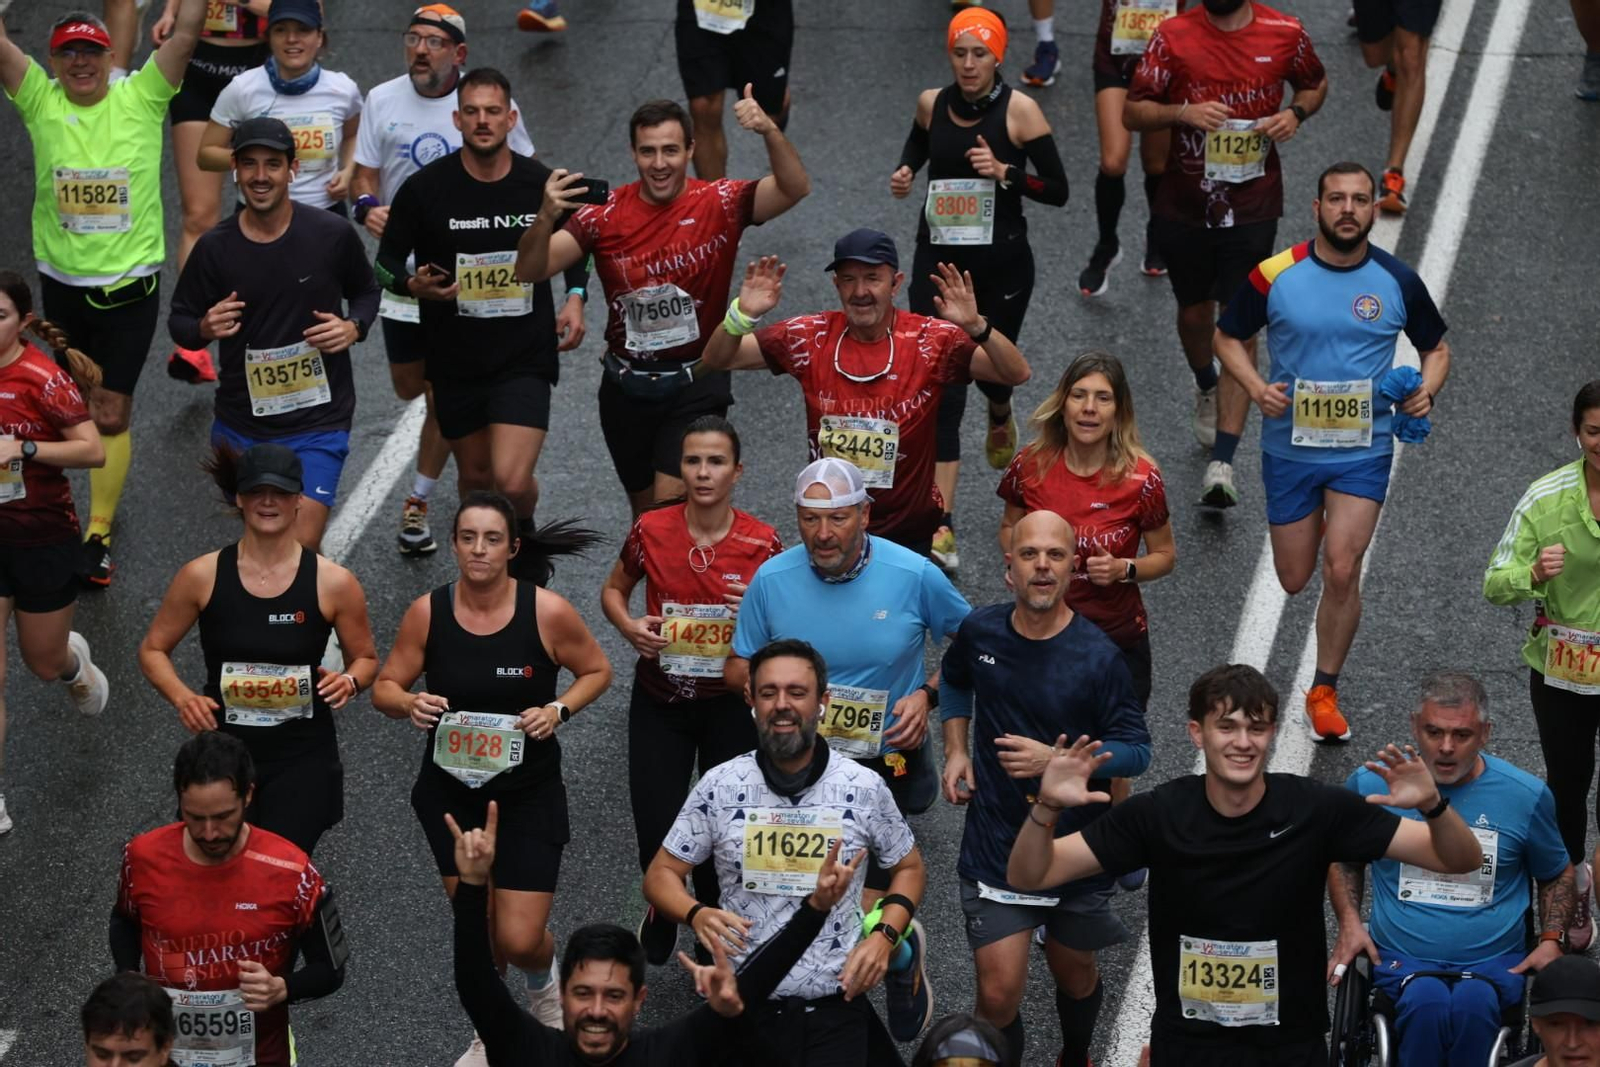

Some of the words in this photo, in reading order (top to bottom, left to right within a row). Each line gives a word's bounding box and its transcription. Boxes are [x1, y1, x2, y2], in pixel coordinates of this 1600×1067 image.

[1211, 134, 1260, 155] 11213
[61, 184, 117, 204] 11582
[934, 195, 978, 216] 8308
[449, 217, 490, 230] CrossFit
[463, 268, 520, 290] 11424
[630, 296, 682, 322] 17560
[252, 358, 313, 387] 13575
[1301, 397, 1359, 418] 11198
[669, 621, 734, 645] 14236
[228, 677, 299, 699] 13543
[448, 730, 502, 758] 9128
[753, 831, 825, 858] 11622
[1188, 960, 1262, 988] 13324
